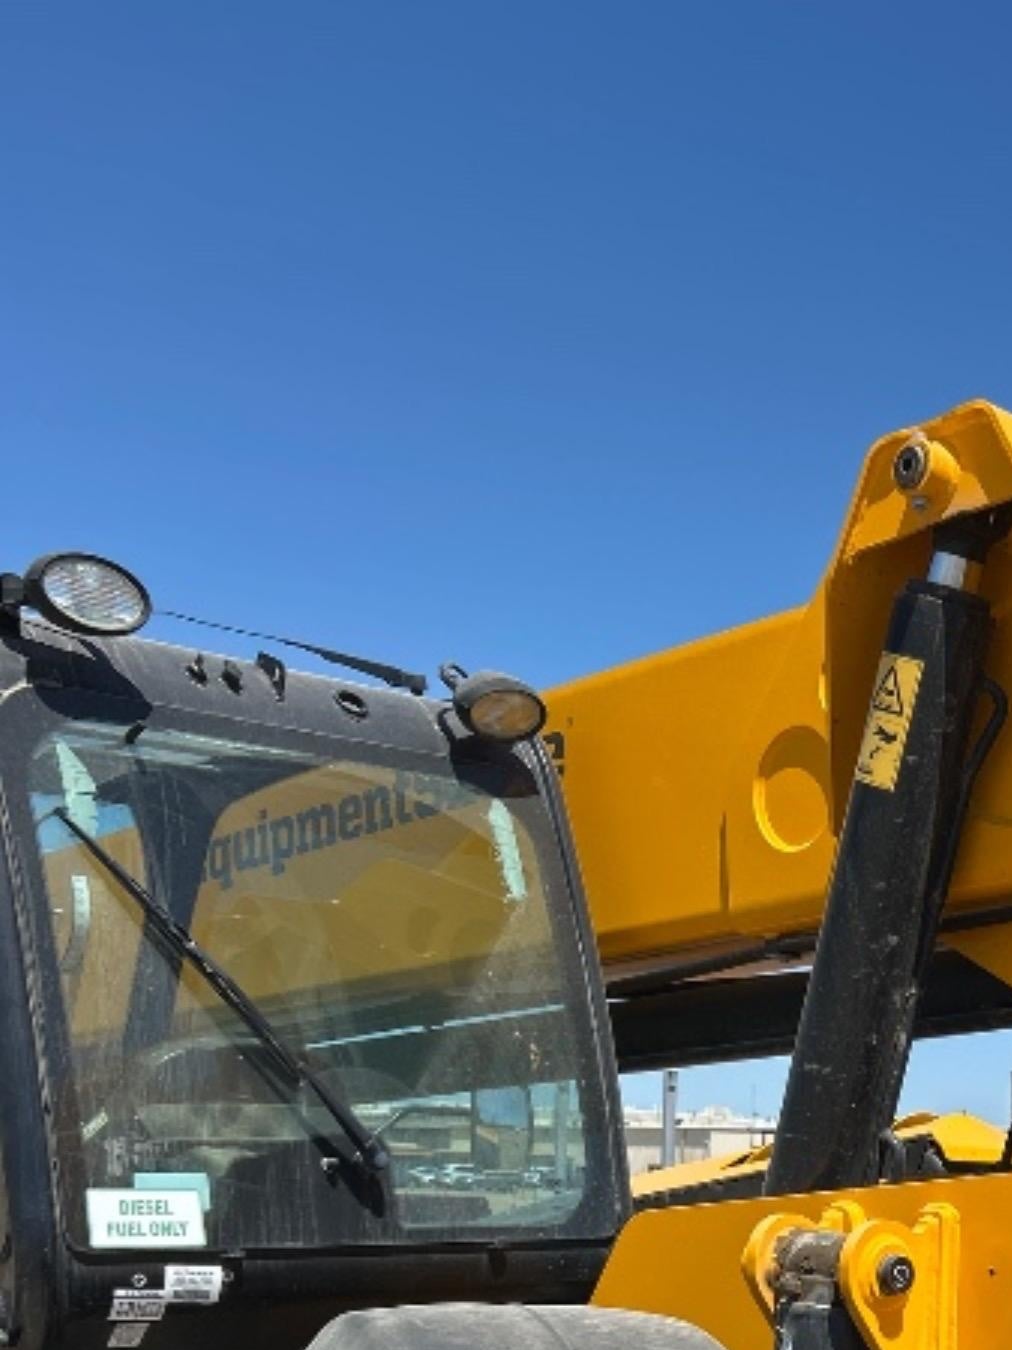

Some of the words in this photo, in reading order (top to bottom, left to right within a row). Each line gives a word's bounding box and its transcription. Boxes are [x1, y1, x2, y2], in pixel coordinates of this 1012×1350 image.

[119, 1199, 174, 1216] DIESEL
[106, 1221, 147, 1238] FUEL
[149, 1221, 190, 1238] ONLY
